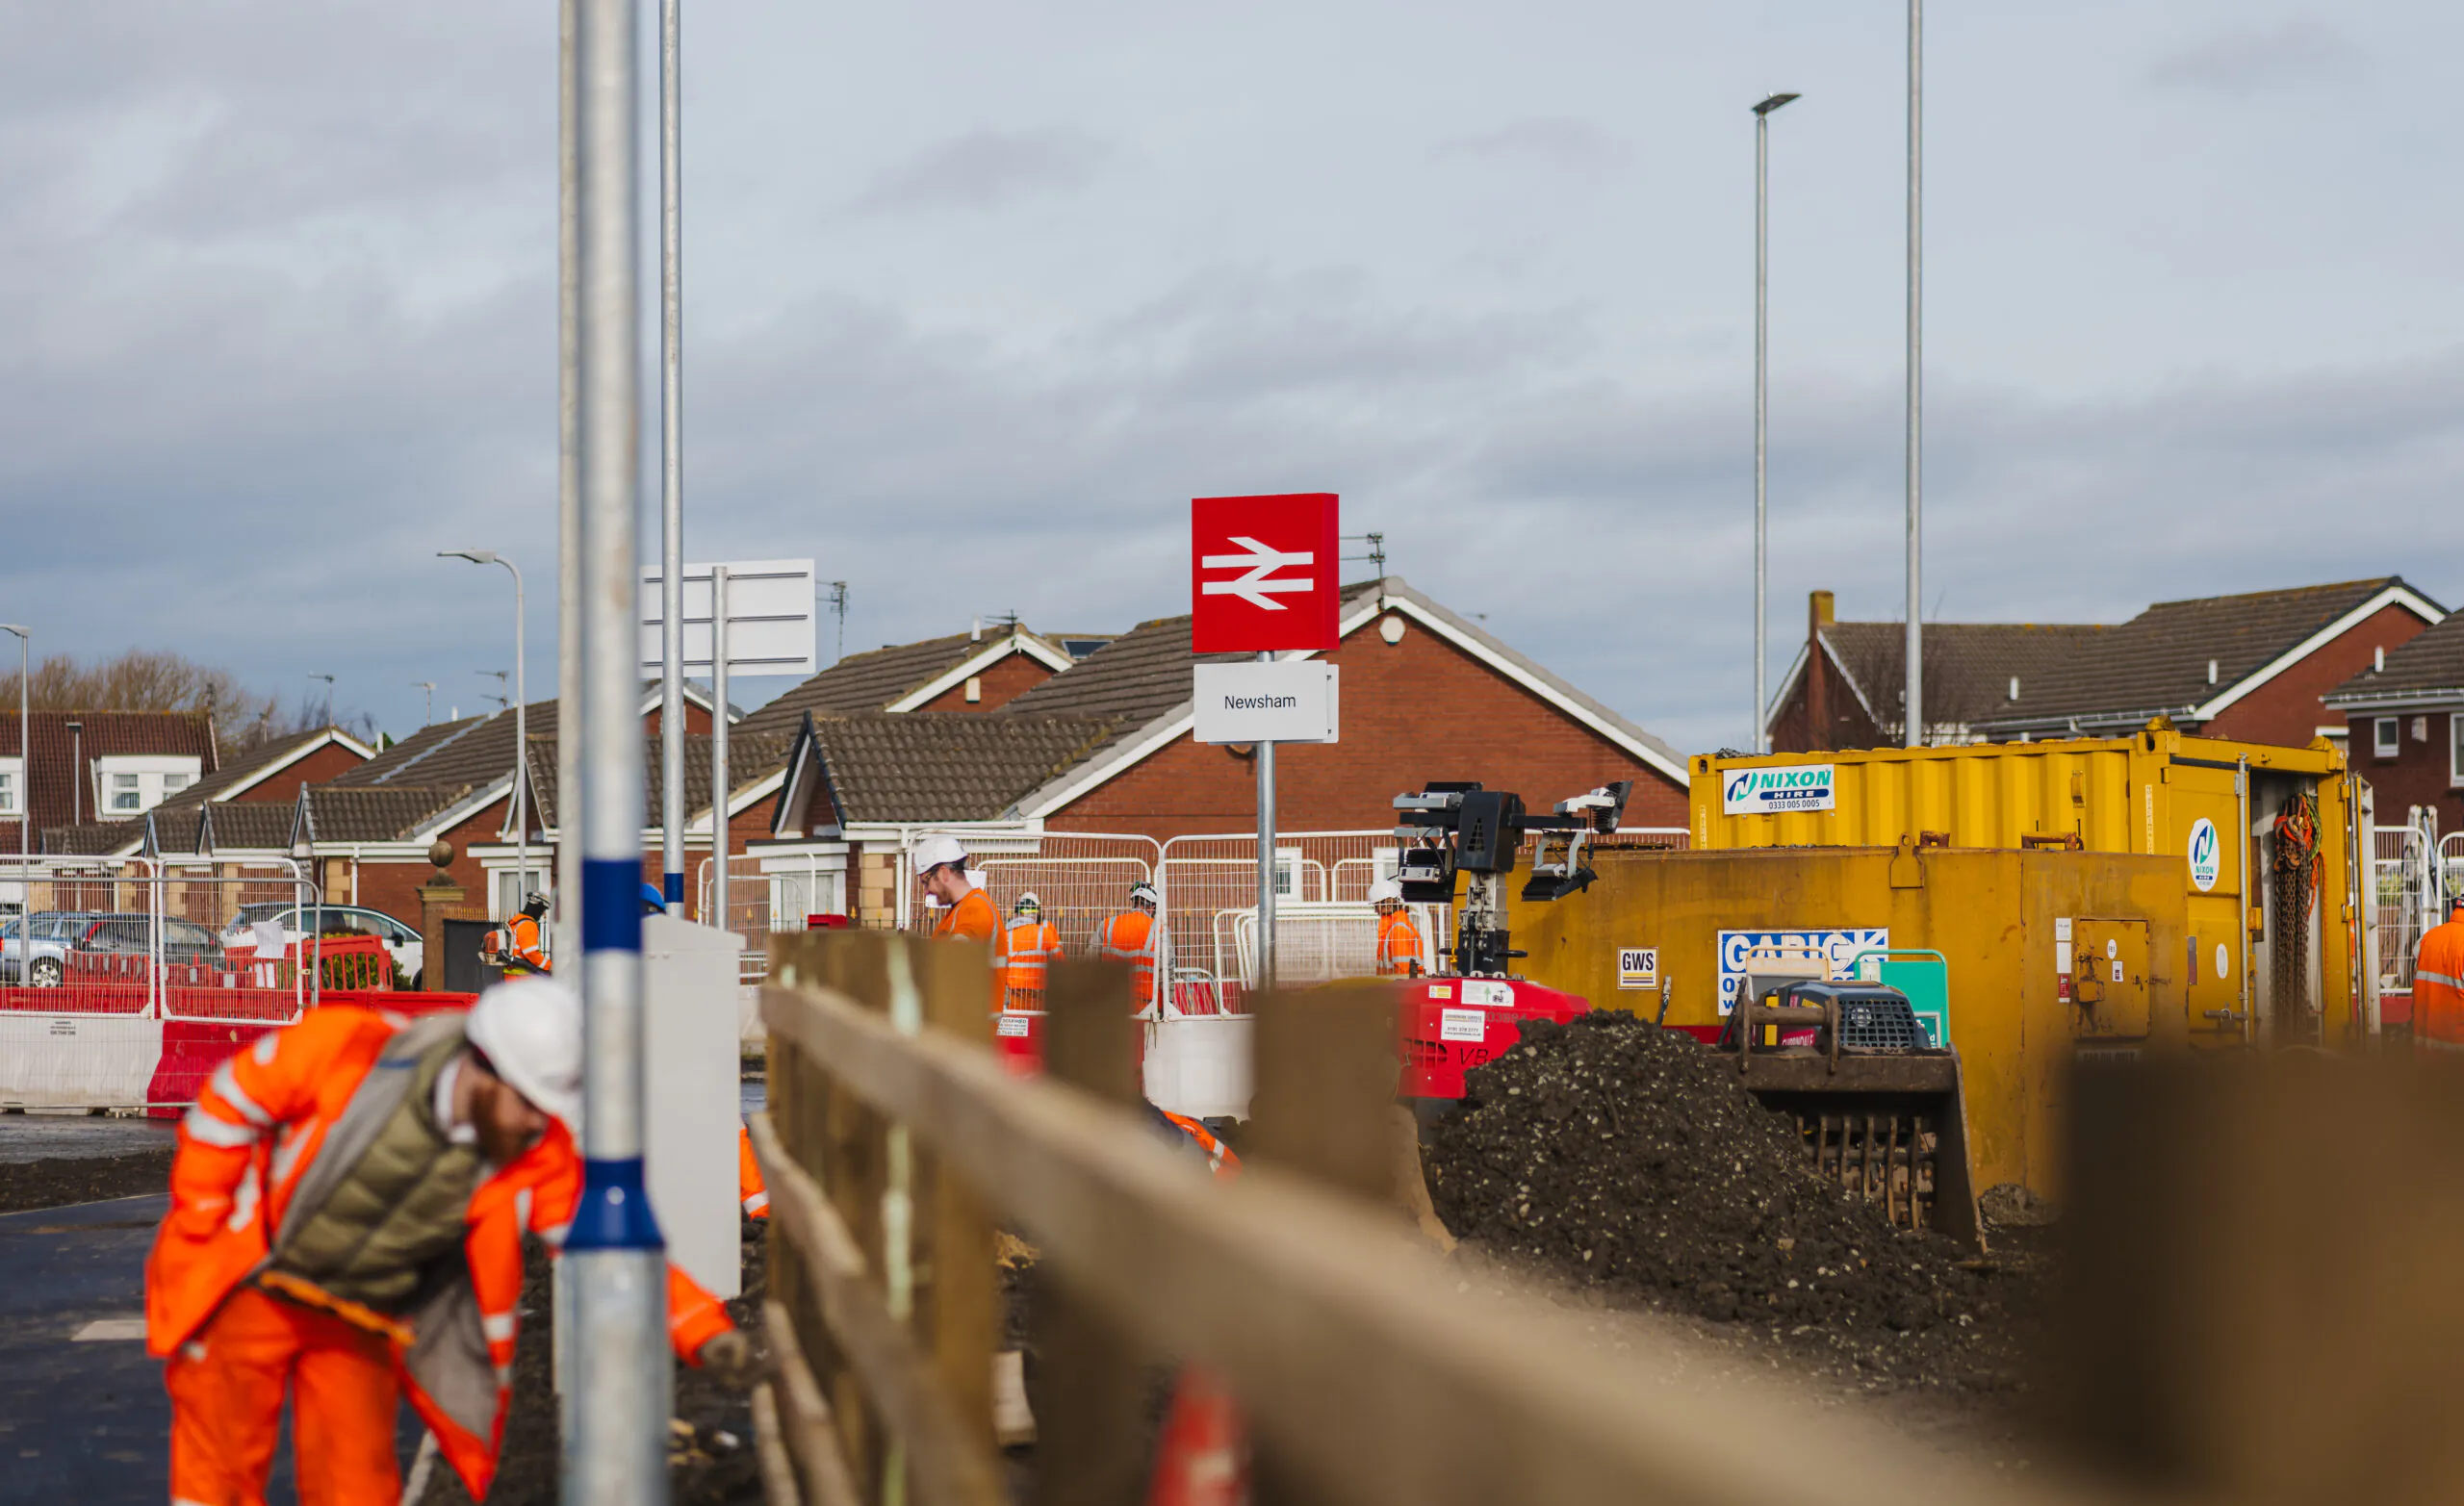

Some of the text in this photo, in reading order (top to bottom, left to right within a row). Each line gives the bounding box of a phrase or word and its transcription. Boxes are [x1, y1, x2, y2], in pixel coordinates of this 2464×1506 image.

[1224, 694, 1296, 710] Newsham
[1759, 770, 1832, 789] NIXON
[1773, 790, 1815, 799] HIRE
[1768, 799, 1820, 810] 0333 005 0005
[2194, 865, 2214, 875] NIXON
[1622, 952, 1655, 971] GWS
